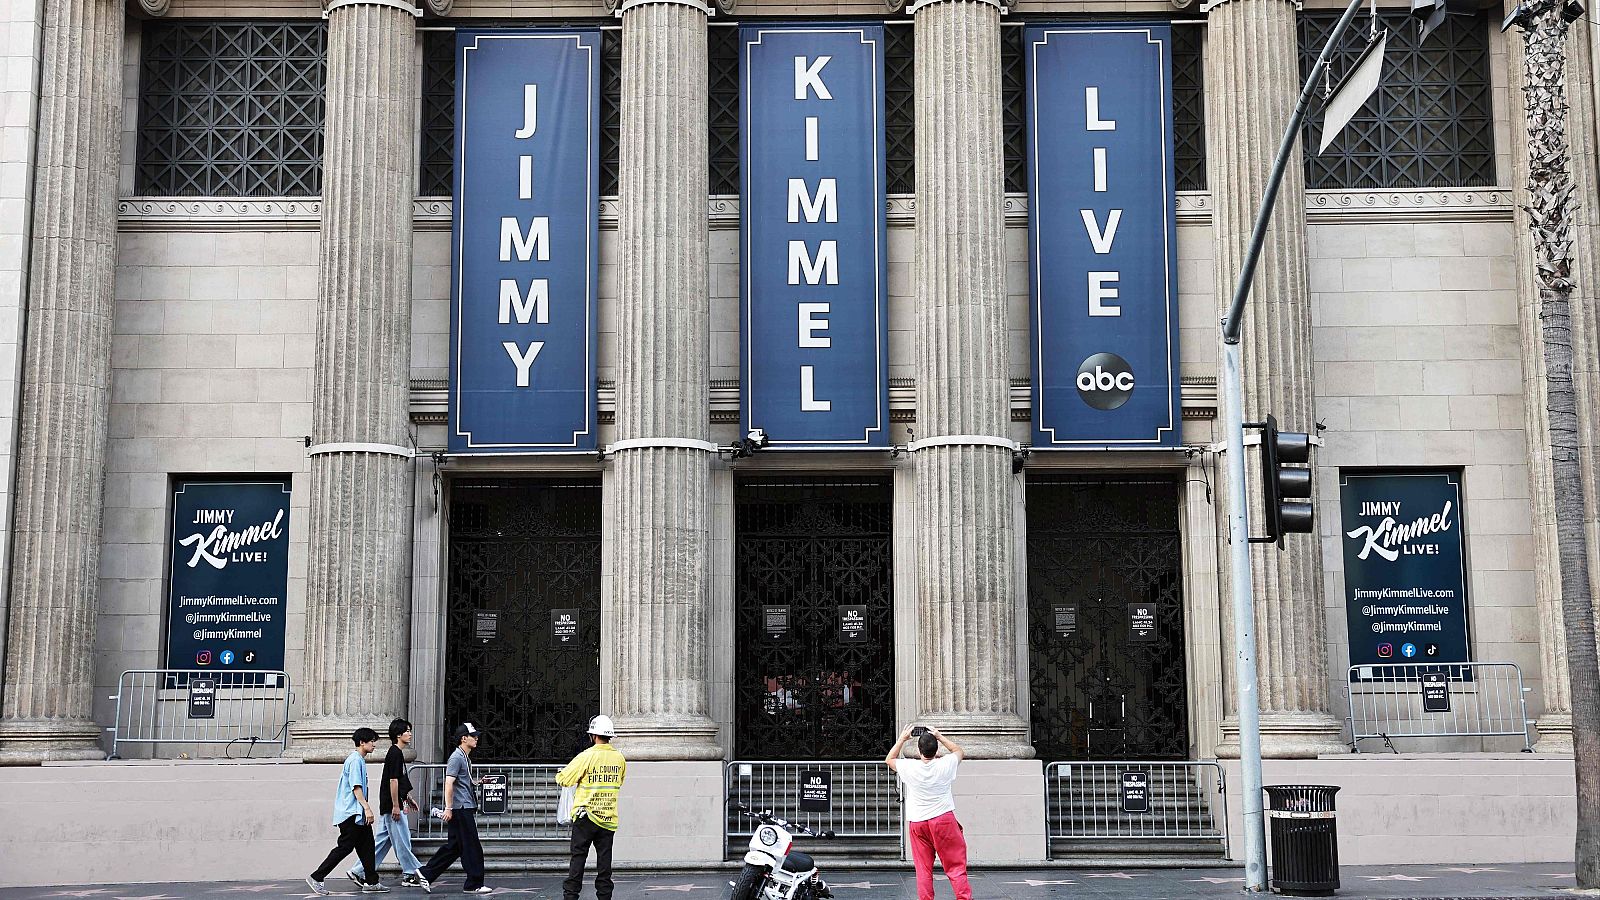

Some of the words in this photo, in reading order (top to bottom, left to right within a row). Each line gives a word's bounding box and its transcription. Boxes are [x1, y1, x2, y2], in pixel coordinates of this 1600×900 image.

[1080, 86, 1123, 317] LIVE
[499, 84, 550, 387] JIMMY
[787, 56, 839, 411] KIMMEL
[1076, 365, 1134, 391] abc
[1359, 501, 1401, 516] JIMMY
[193, 509, 235, 524] JIMMY
[1346, 500, 1452, 562] Kimmel
[178, 508, 284, 570] Kimmel
[1403, 544, 1440, 555] LIVE!
[232, 552, 267, 563] LIVE!
[1354, 587, 1454, 600] JimmyKimmelLive.com
[179, 595, 278, 608] JimmyKimmelLive.com
[847, 610, 858, 618] NO
[1137, 608, 1148, 616] NO
[1361, 604, 1449, 617] @JimmyKimmelLive
[185, 612, 271, 624] @JimmyKimmelLive
[560, 614, 571, 622] NO
[1371, 620, 1442, 633] @JimmyKimmel
[193, 628, 262, 641] @JimmyKimmel
[810, 776, 822, 785] NO
